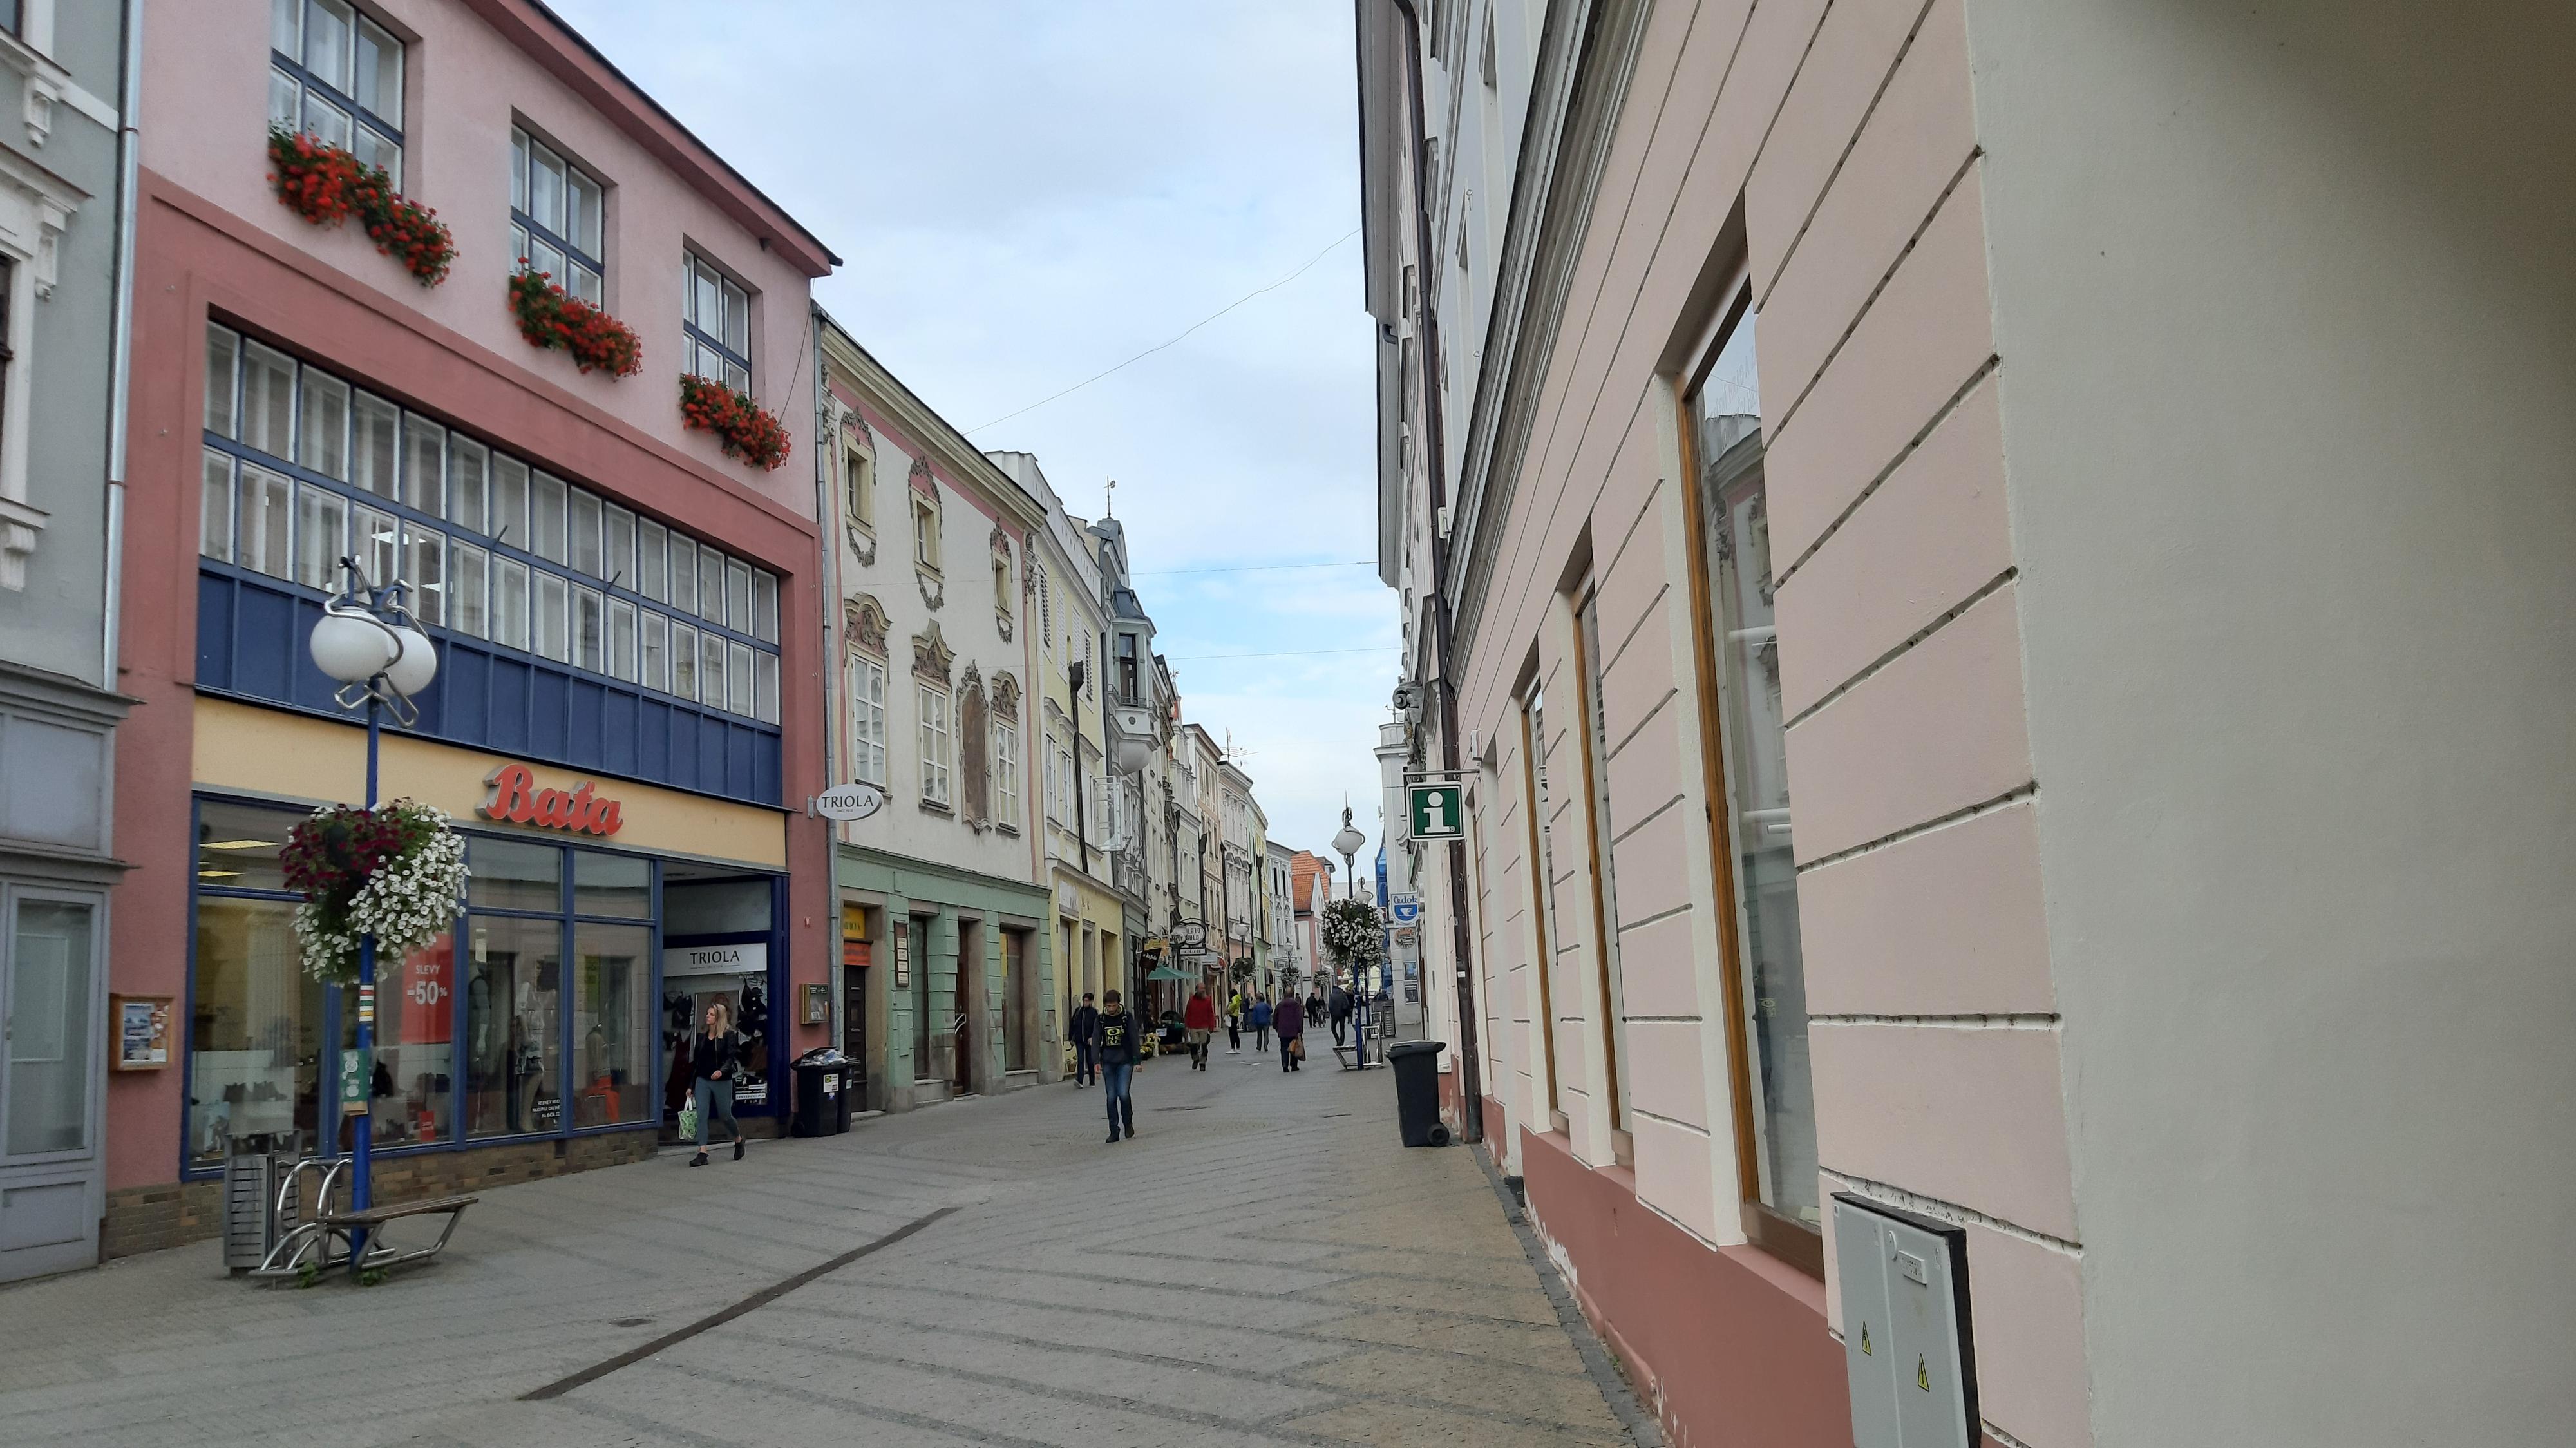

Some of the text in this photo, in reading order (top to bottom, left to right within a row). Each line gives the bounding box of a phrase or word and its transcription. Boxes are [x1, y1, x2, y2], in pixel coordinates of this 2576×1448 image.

[822, 795, 874, 808] TRIOLA
[690, 950, 740, 964] TRIOLA
[415, 964, 441, 975] SLEVY
